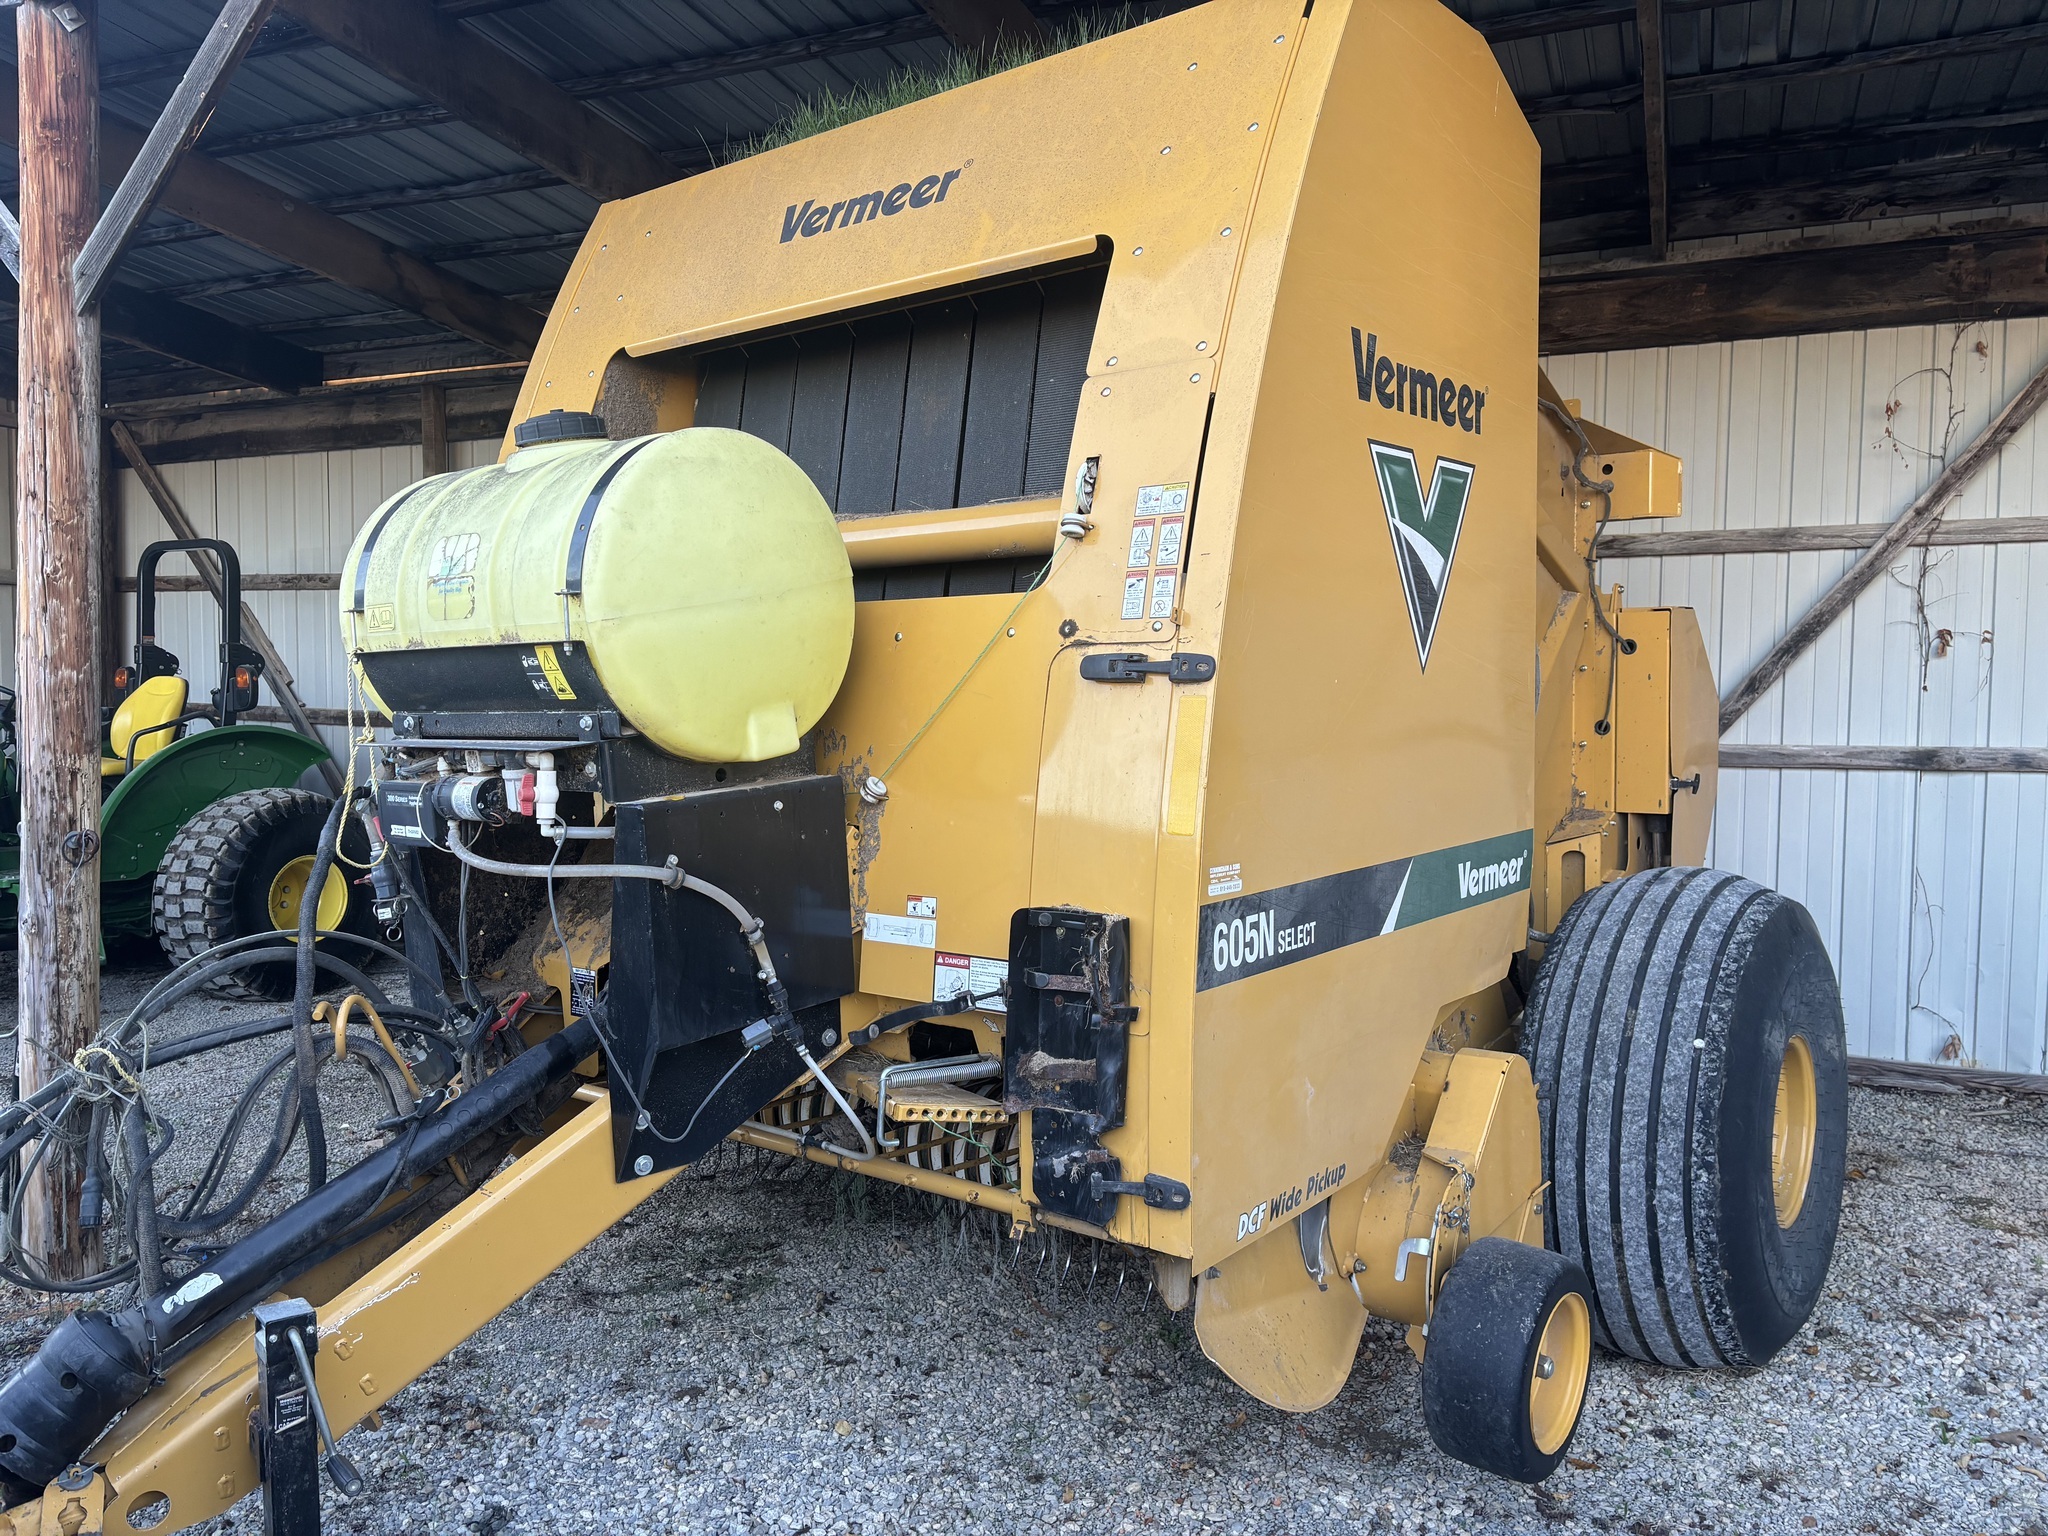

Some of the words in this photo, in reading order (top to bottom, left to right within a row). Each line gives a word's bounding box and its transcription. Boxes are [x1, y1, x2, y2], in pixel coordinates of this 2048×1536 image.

[944, 957, 969, 966] DANGER
[1213, 909, 1275, 972] 605N
[1278, 921, 1316, 954] SELECT
[1237, 1201, 1268, 1242] DCF
[1270, 1186, 1303, 1222] Wide
[1306, 1163, 1346, 1201] Pickup
